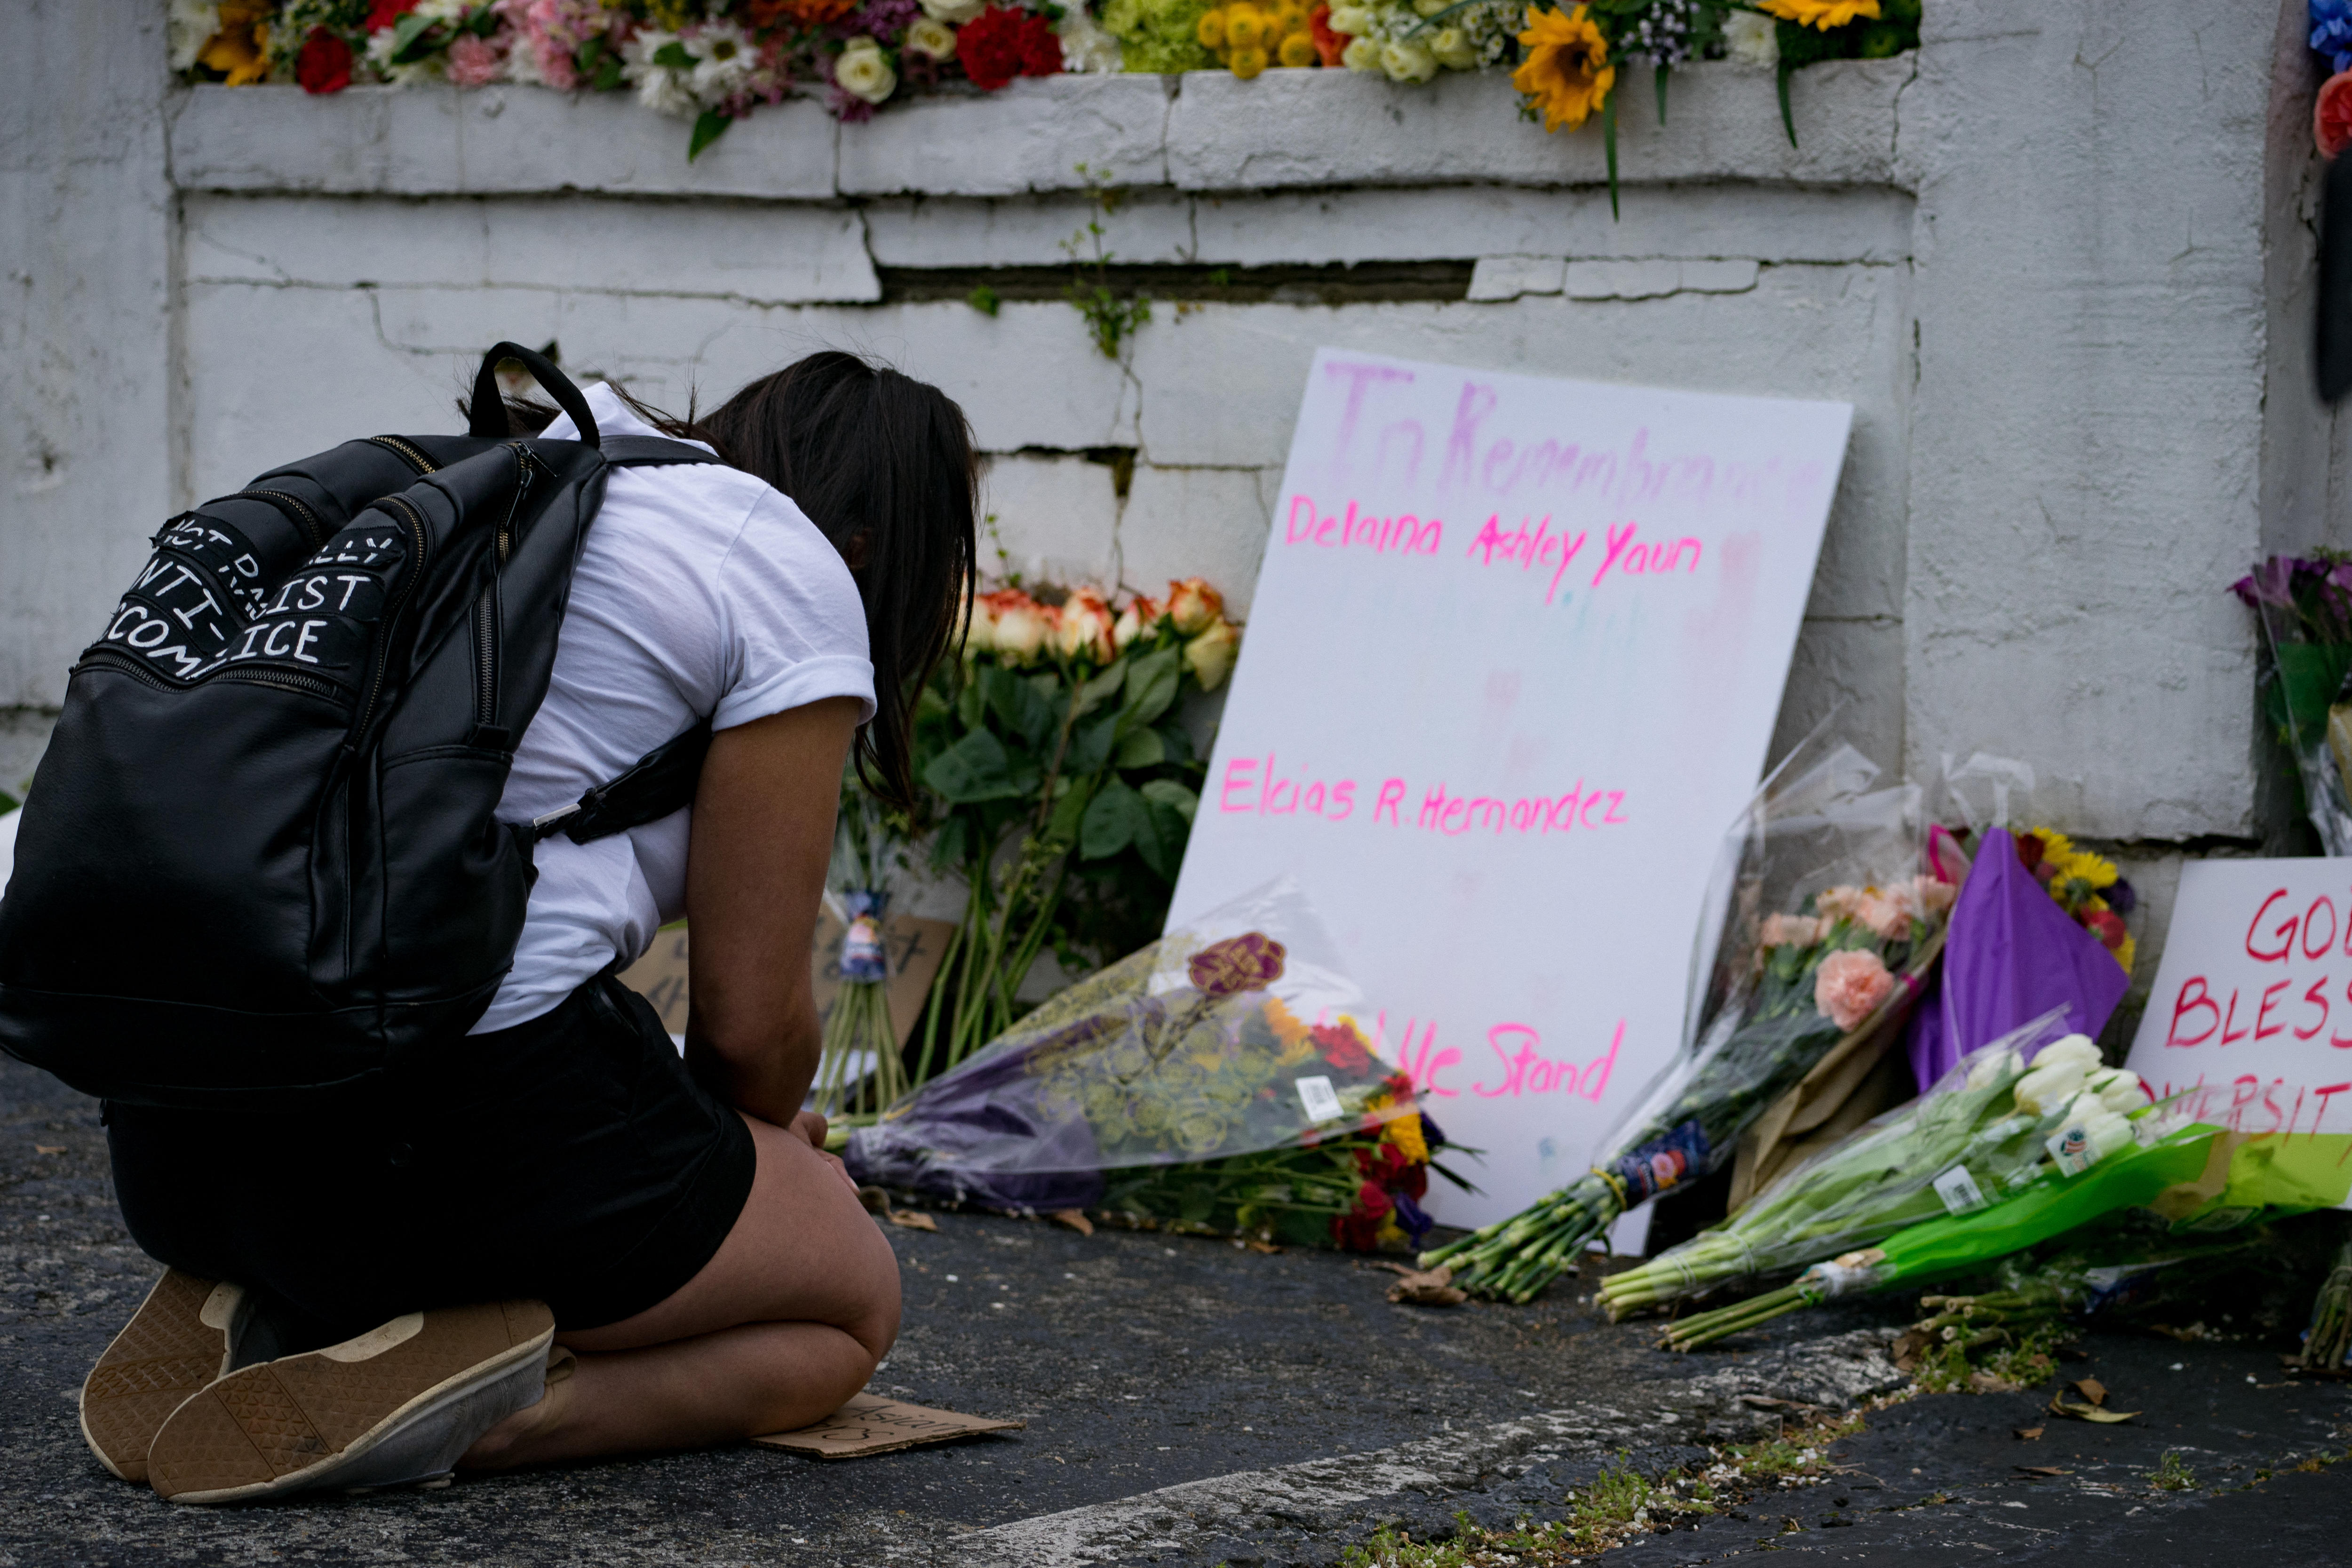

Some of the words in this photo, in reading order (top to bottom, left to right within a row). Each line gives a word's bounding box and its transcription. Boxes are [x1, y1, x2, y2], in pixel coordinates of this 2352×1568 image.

[1285, 494, 1444, 557] Delaina
[1466, 512, 1588, 605] Ashley
[1417, 779, 1628, 836] Hernandez
[1471, 1019, 1627, 1104] Stand
